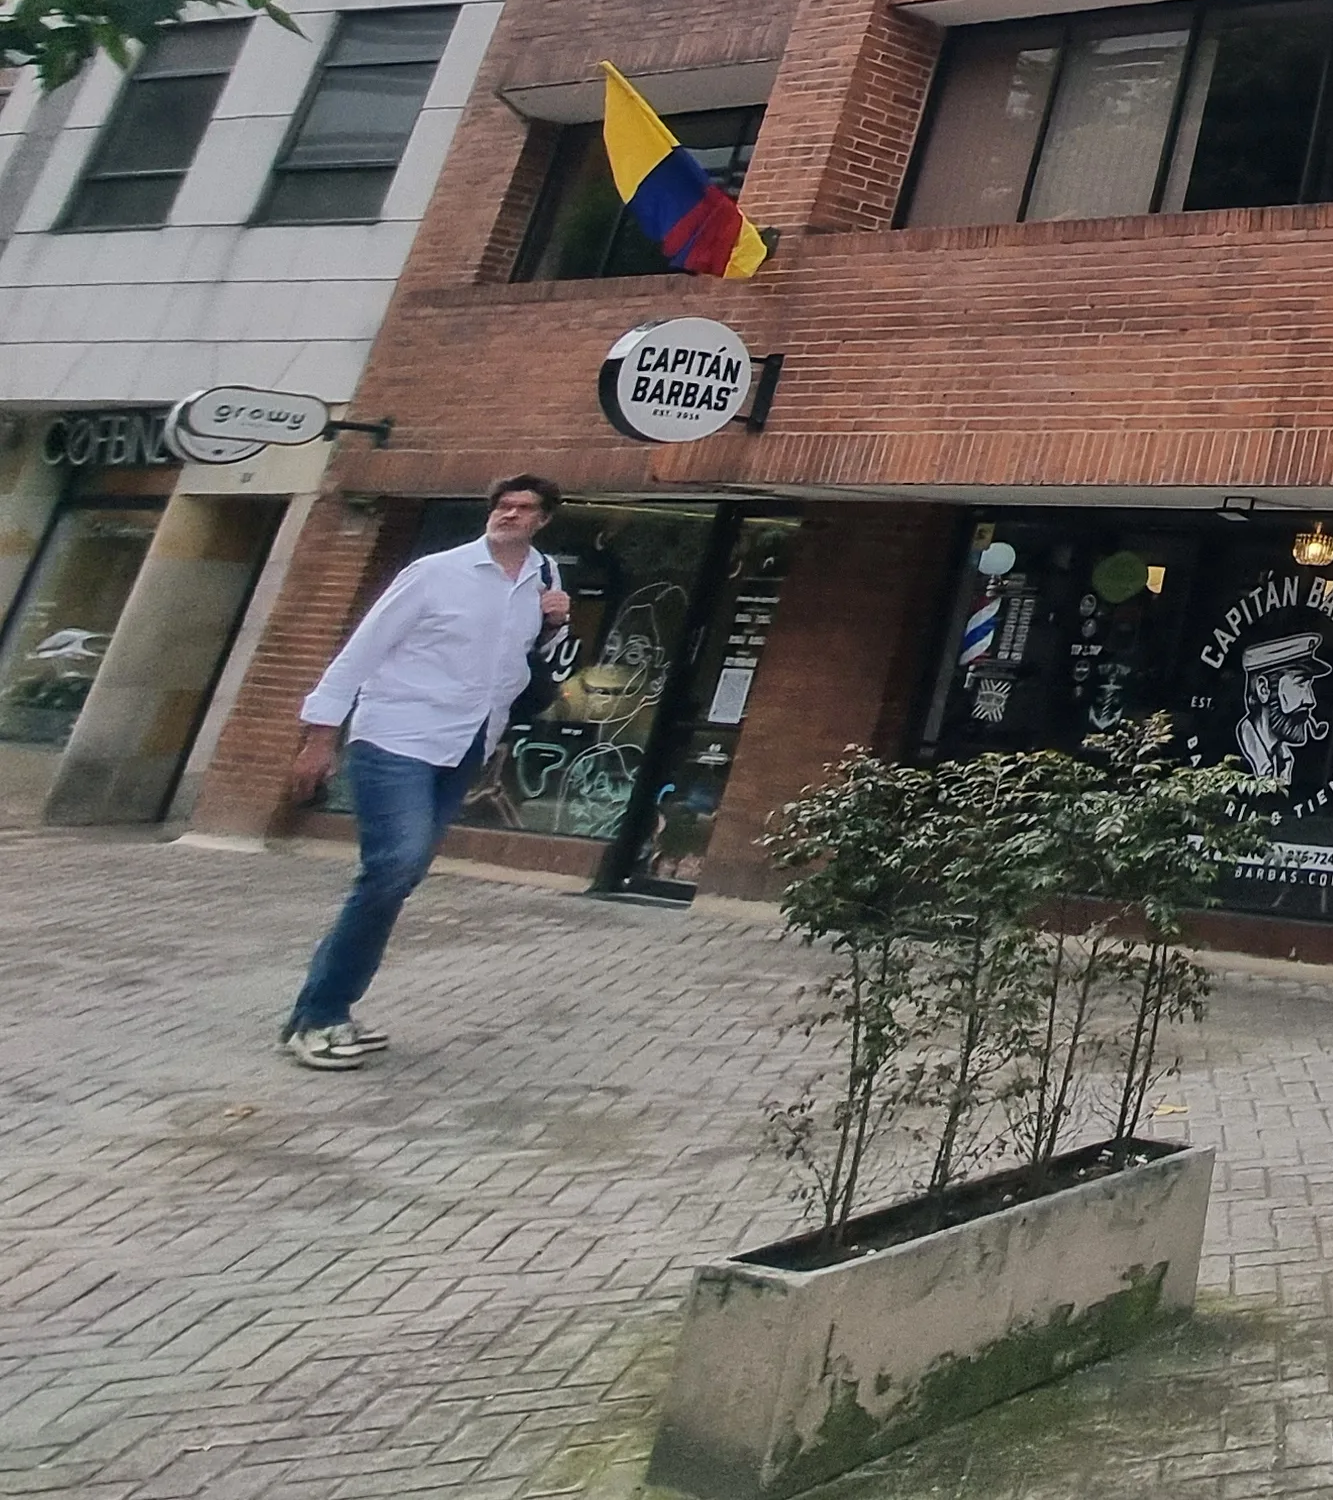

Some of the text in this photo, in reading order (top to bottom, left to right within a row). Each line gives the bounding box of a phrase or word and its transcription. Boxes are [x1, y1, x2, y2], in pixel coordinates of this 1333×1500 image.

[636, 346, 742, 385] CAPITÁN
[213, 404, 307, 431] growy
[1200, 570, 1300, 669] CAPITÁN
